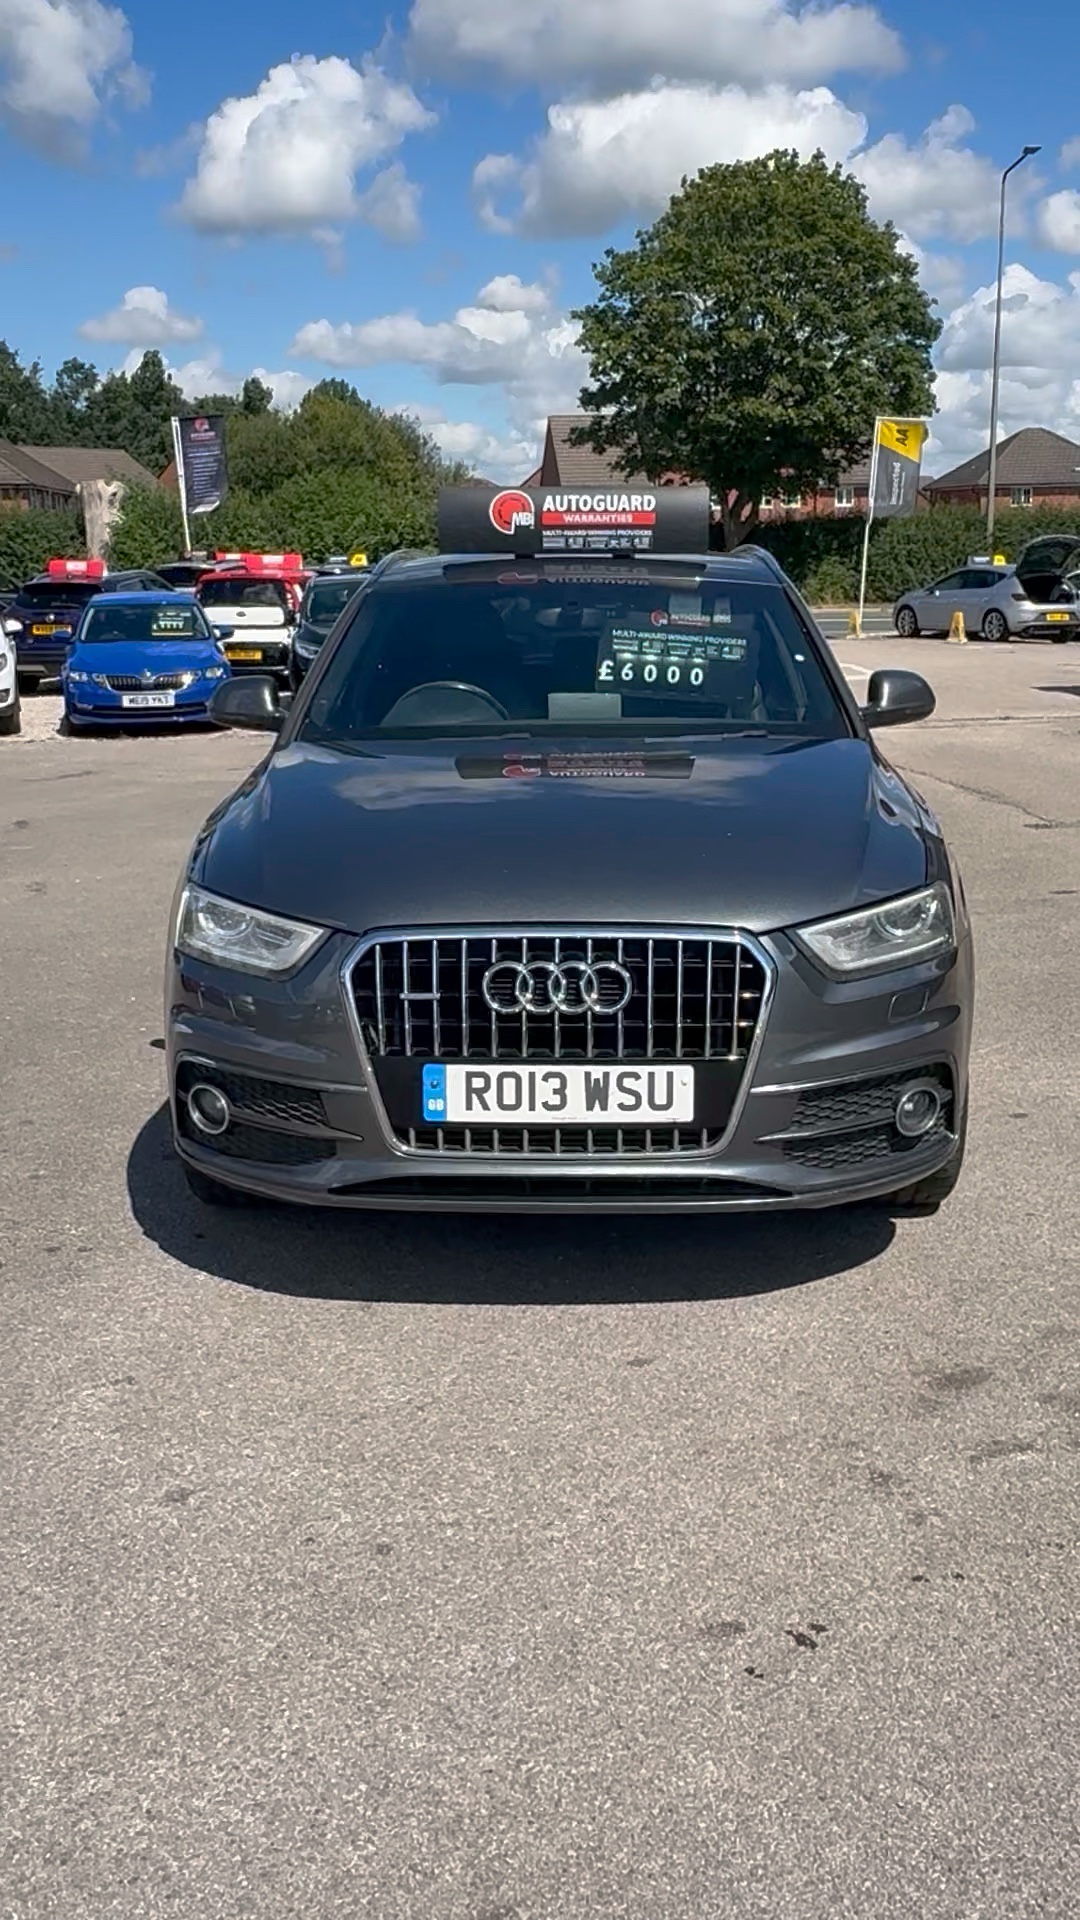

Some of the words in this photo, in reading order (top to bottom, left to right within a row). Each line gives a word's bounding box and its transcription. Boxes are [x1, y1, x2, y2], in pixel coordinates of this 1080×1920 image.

[895, 428, 909, 446] AA
[543, 494, 657, 512] AUTOGUARD
[563, 513, 633, 524] WARRANTIES
[704, 635, 747, 645] PROVIDERS
[465, 1071, 568, 1112] RO13
[584, 1071, 675, 1112] WSU
[427, 1098, 445, 1111] GB
